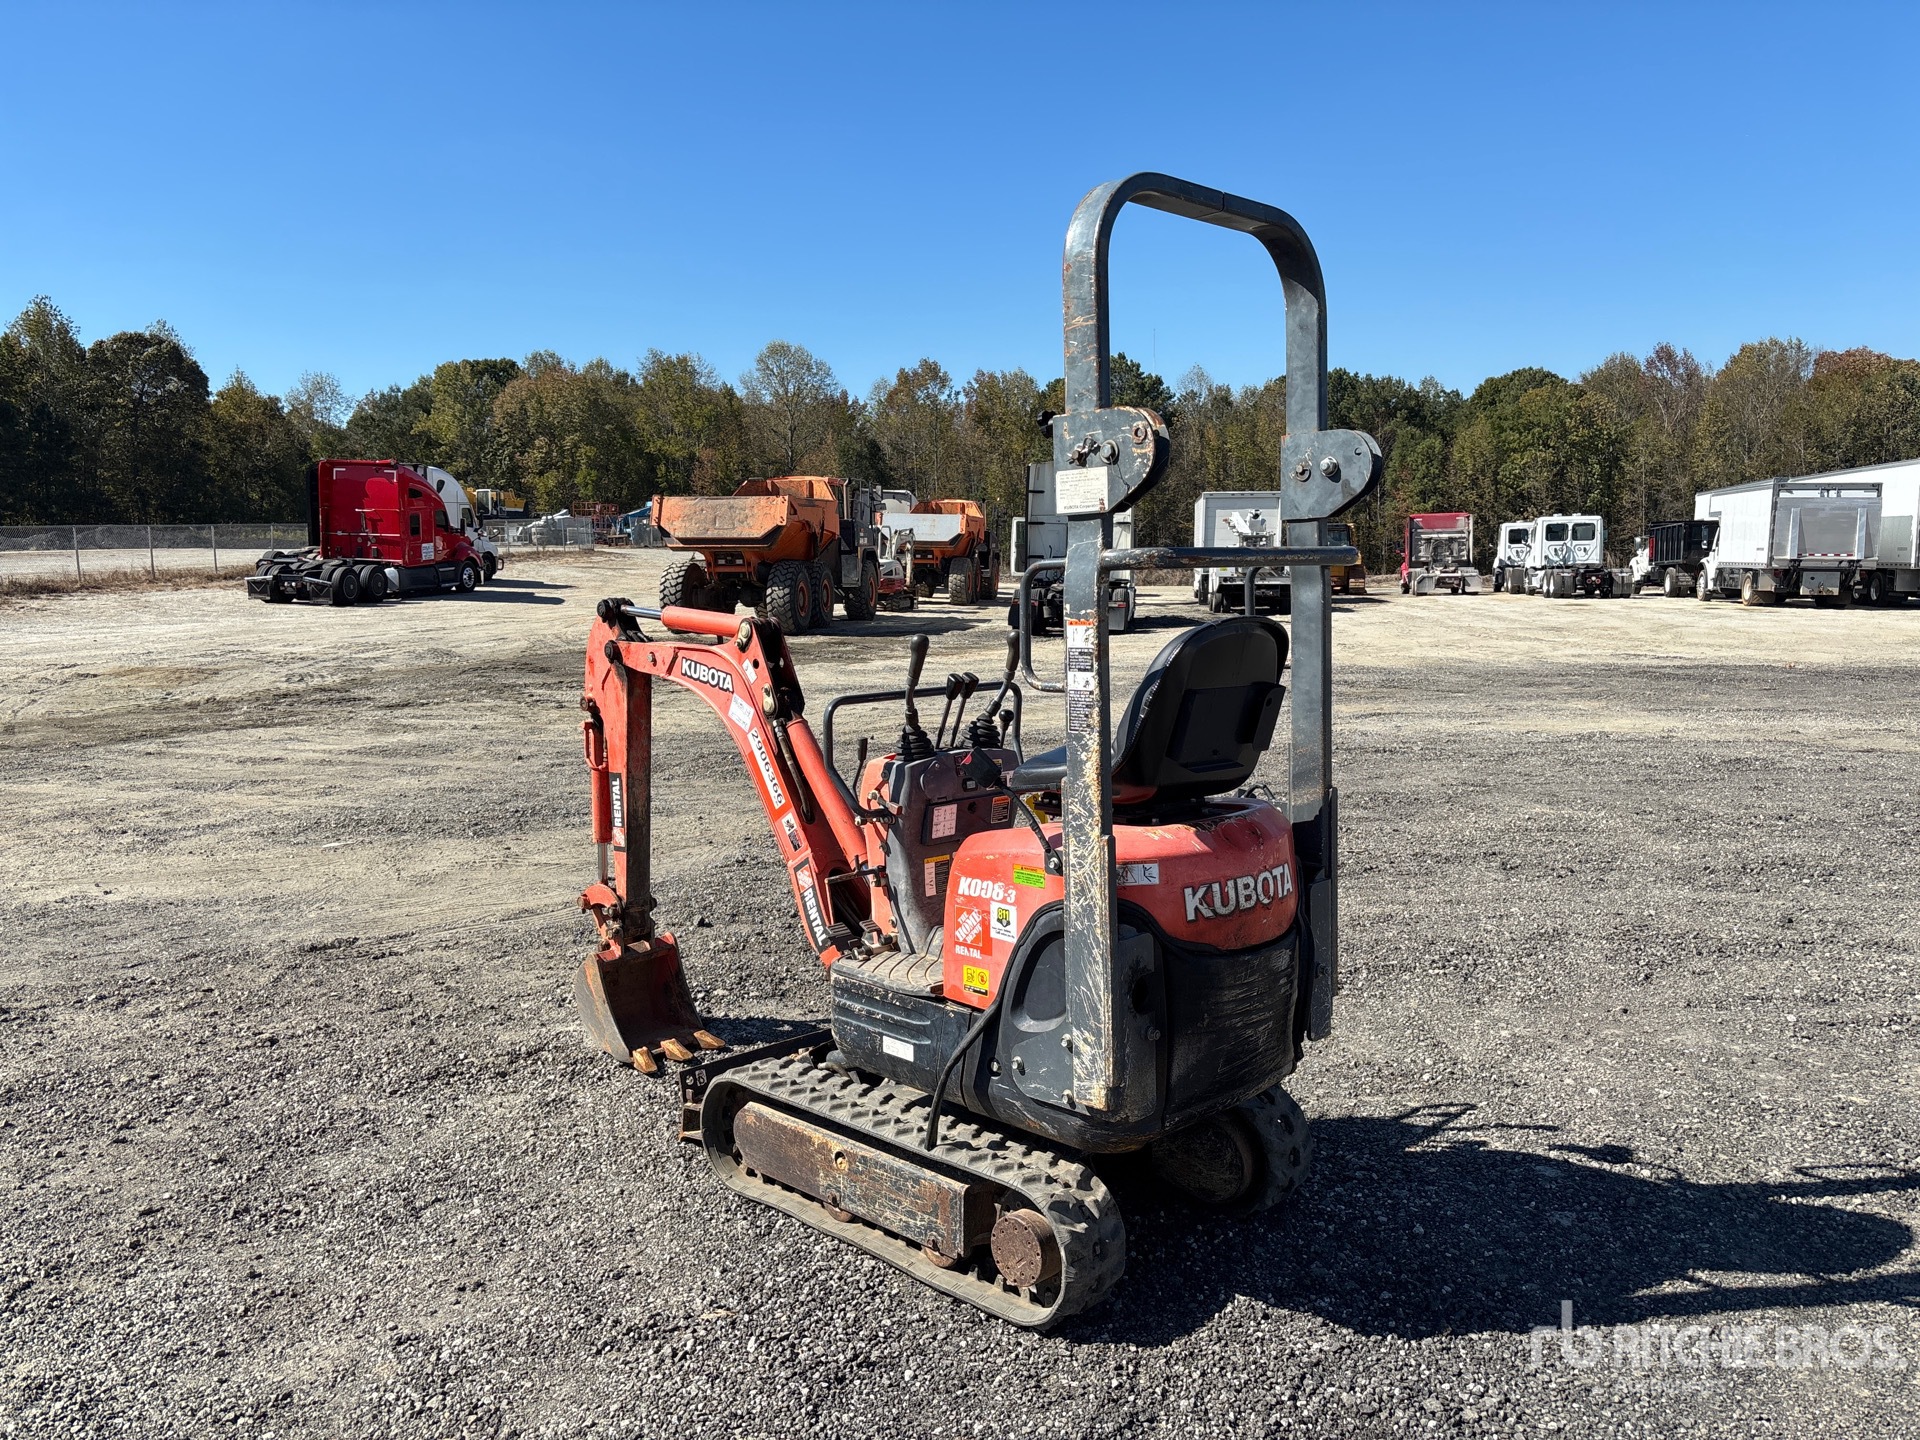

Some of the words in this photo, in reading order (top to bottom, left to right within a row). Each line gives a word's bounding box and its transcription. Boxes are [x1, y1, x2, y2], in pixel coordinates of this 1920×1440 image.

[681, 657, 734, 692] KUBOTA
[751, 730, 784, 804] 2906366
[612, 778, 624, 827] RENTAL
[1184, 863, 1293, 922] KUBOTA
[803, 888, 828, 946] RENTAL
[955, 909, 983, 942] HOME
[957, 911, 968, 925] THE
[998, 908, 1009, 921] 811
[965, 922, 982, 944] DEPOT
[956, 944, 983, 961] RENTAL
